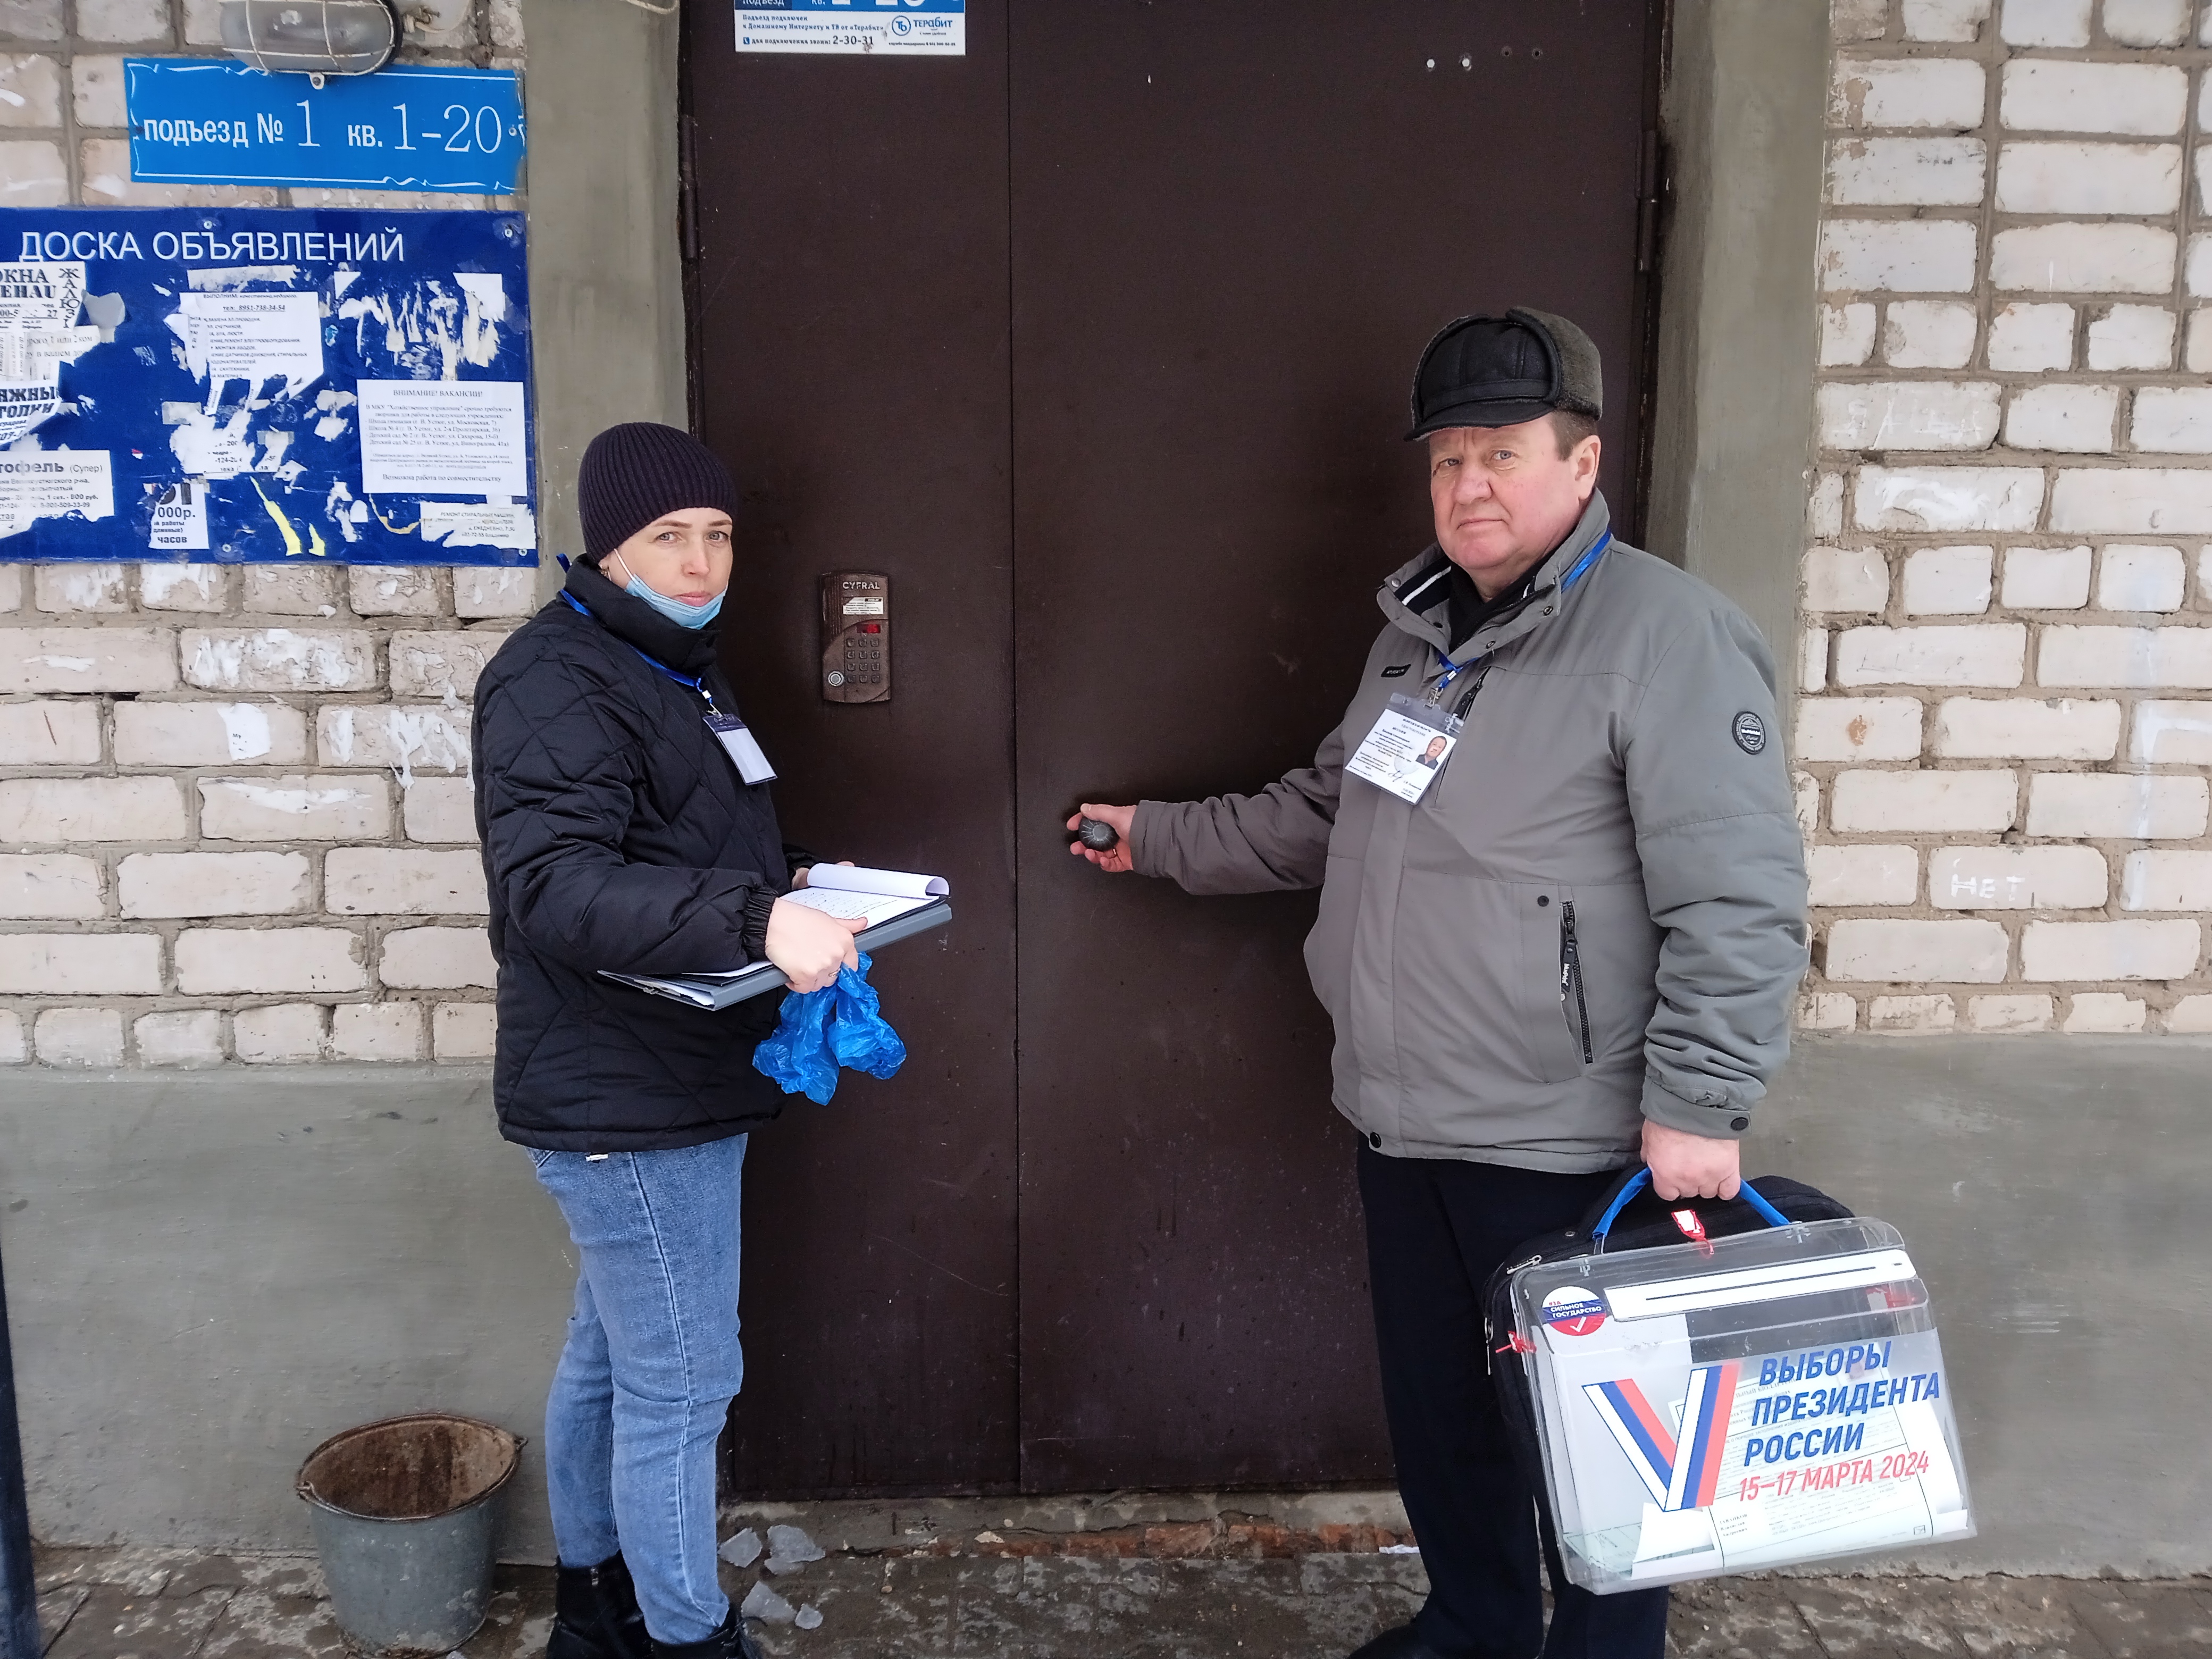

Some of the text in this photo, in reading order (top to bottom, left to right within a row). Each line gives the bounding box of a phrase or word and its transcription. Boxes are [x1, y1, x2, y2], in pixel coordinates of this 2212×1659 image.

[833, 35, 874, 46] 2-30-31
[144, 99, 502, 154] подъезд № 1 кв. 1-20
[19, 227, 405, 263] ДОСКА ОБЪЯВЛЕНИЙ
[0, 269, 49, 283] КНА
[70, 464, 103, 474] (Супер)
[158, 507, 196, 520] 000р.
[842, 581, 881, 590] CYFRAL
[1550, 1303, 1584, 1312] СИЛЬНОЕ
[1552, 1306, 1602, 1319] ГОСУДАРСТВО
[1759, 1340, 1892, 1386] ВЫБОРЫ
[1751, 1371, 1940, 1427] ПРЕЗИДЕНТА
[1744, 1422, 1865, 1467] РОССИИ
[1801, 1459, 1873, 1492] МАРТА
[1880, 1450, 1929, 1479] 2024
